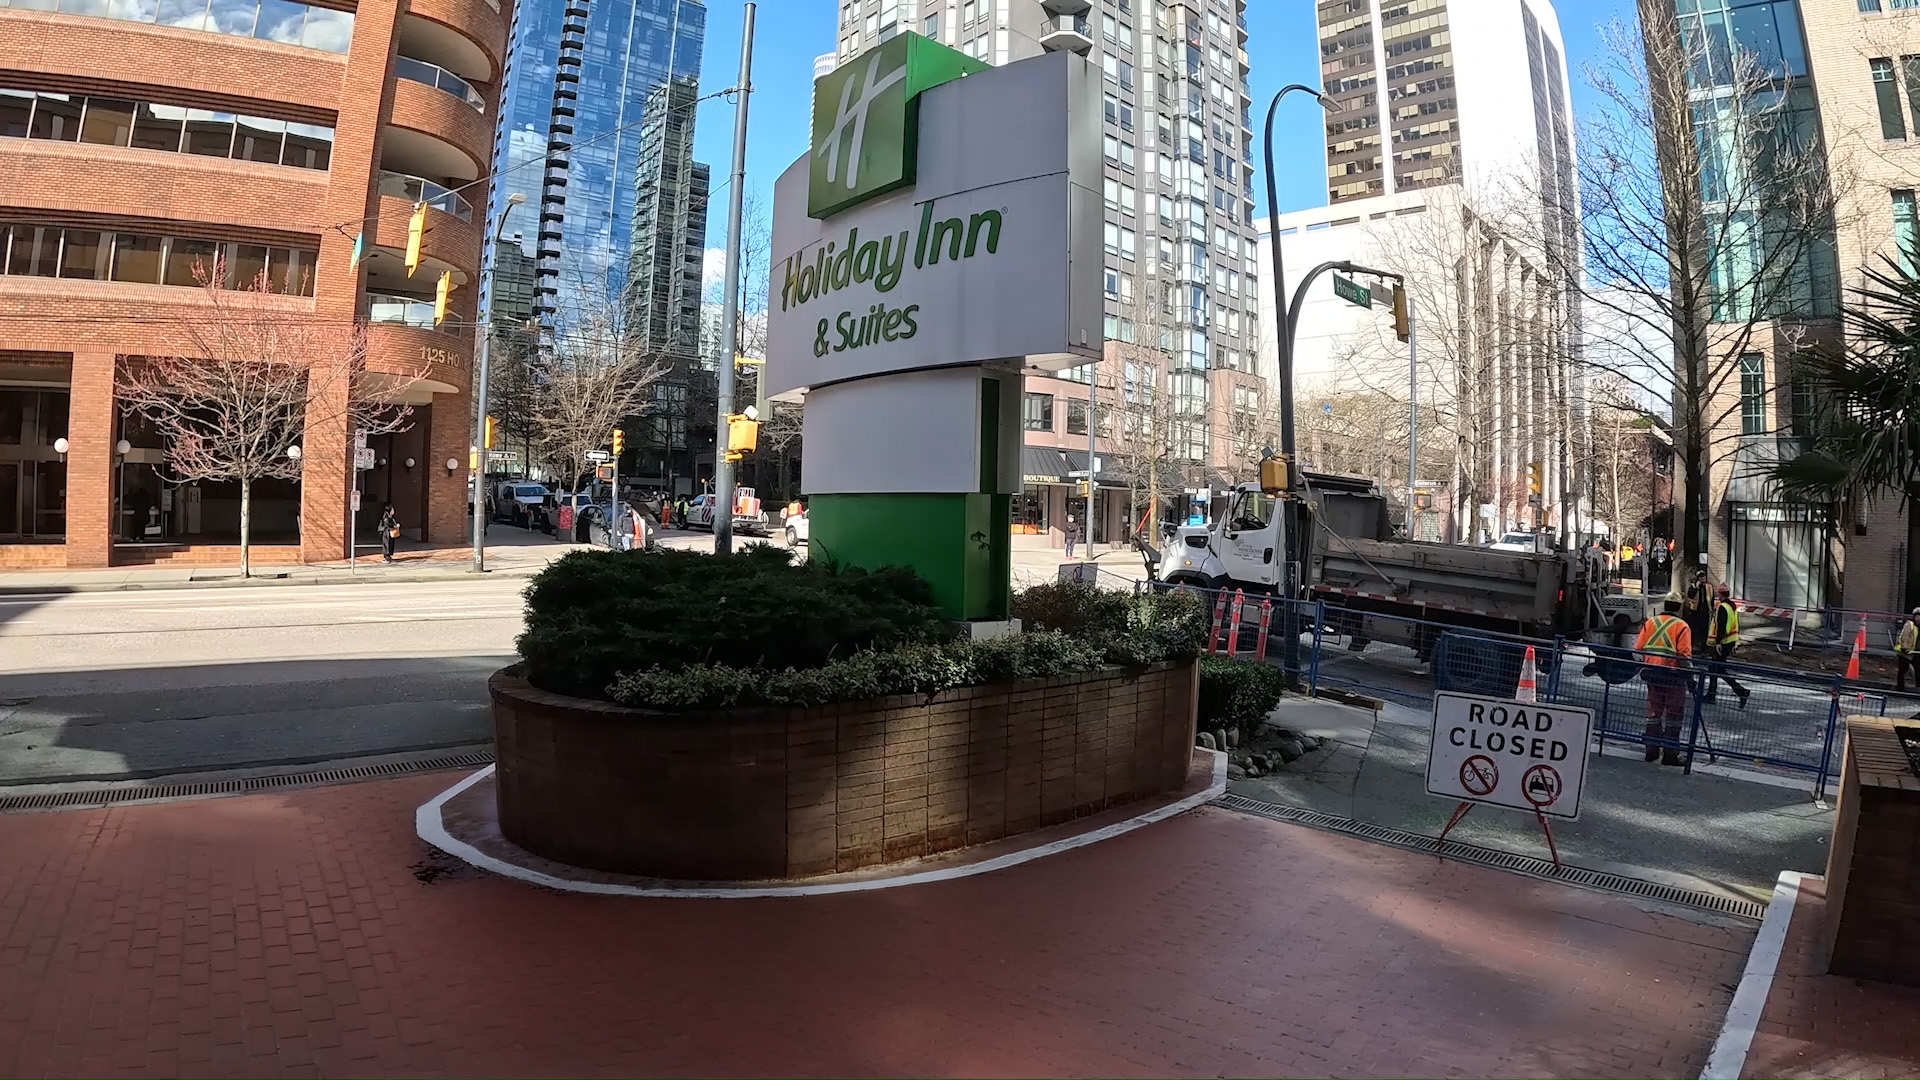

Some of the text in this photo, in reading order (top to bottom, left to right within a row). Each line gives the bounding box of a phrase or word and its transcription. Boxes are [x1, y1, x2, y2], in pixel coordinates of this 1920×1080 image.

[782, 200, 1002, 312] Holiday Inn
[1336, 278, 1369, 305] Howe St
[813, 303, 919, 358] & Suites
[420, 346, 445, 364] 1125
[1023, 474, 1061, 483] BOUTIQUE
[1468, 703, 1553, 732] ROAD
[1450, 727, 1568, 762] CLOSED
